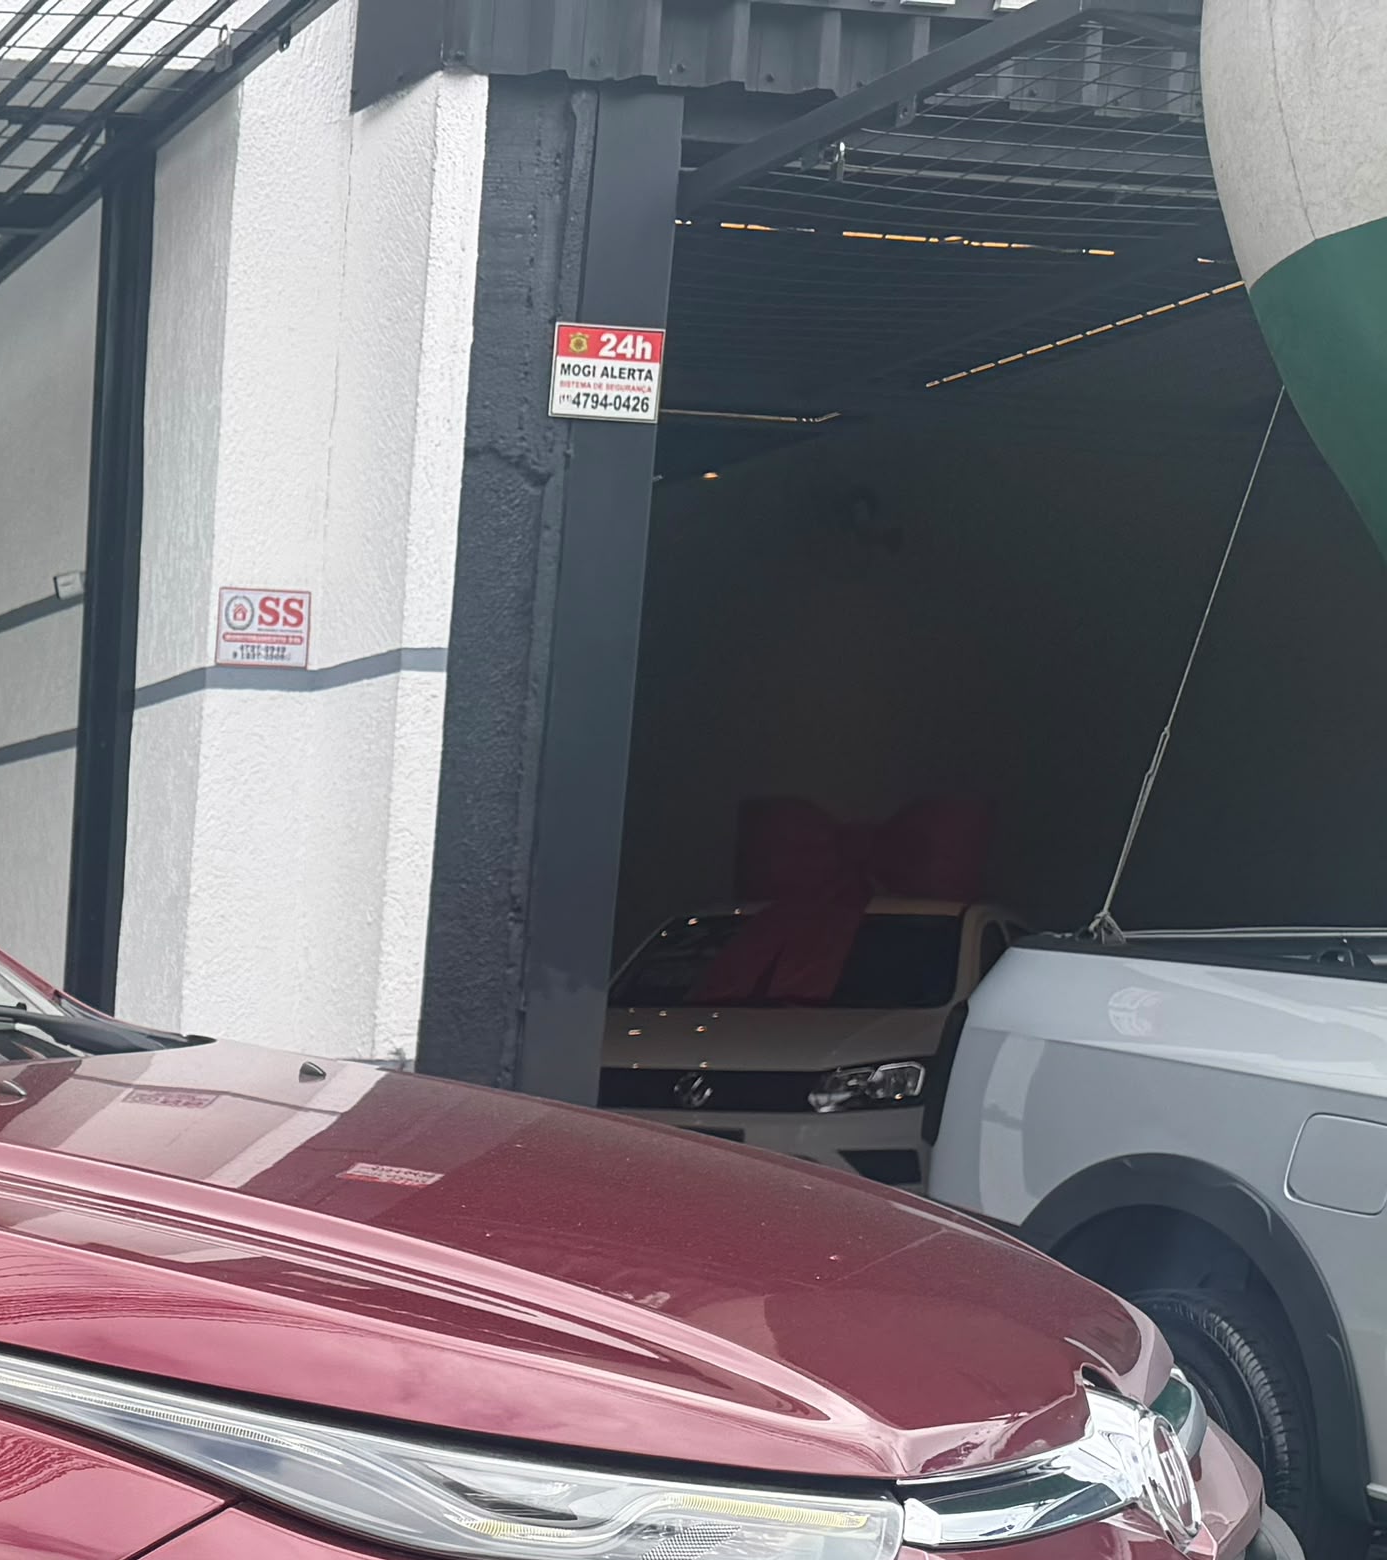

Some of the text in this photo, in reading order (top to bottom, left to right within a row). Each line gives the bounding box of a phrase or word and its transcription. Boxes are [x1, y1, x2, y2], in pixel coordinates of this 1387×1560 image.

[599, 333, 653, 360] 24h
[560, 363, 654, 381] MOGI ALERTA
[258, 596, 304, 628] SS
